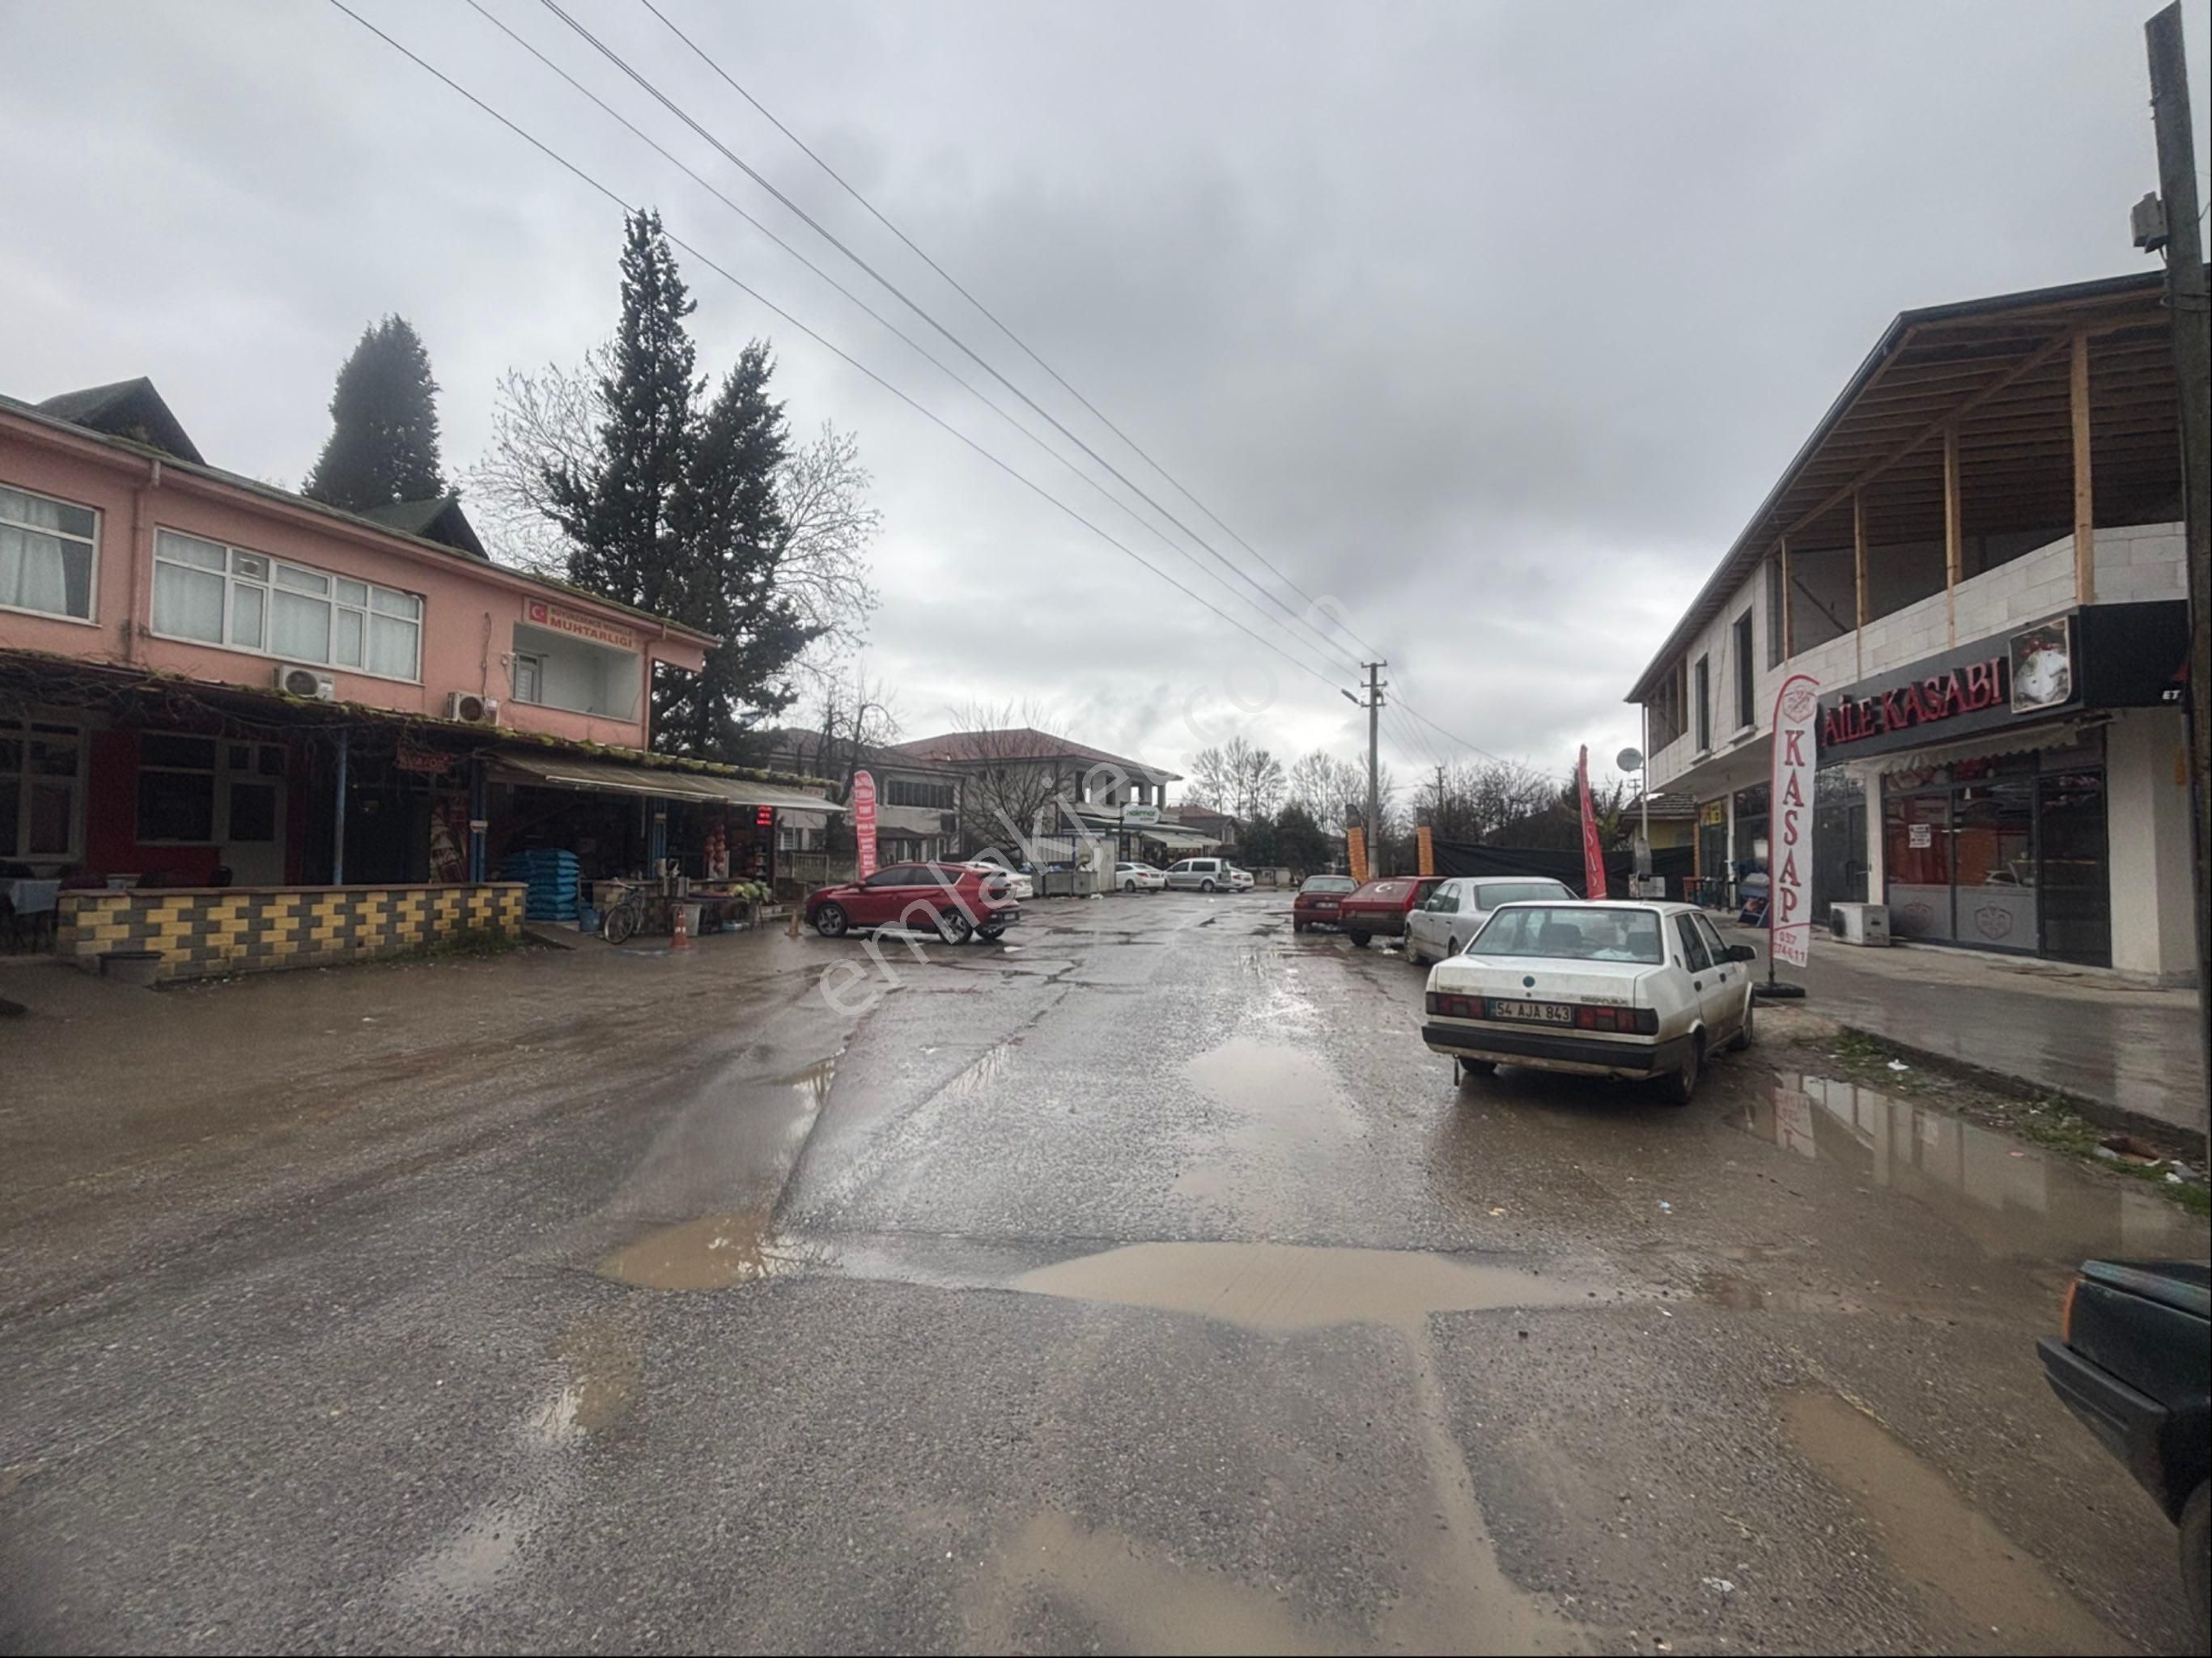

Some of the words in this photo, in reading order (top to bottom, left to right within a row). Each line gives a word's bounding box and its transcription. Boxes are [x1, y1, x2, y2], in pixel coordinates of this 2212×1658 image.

[1823, 695, 1875, 747] AİLE
[1882, 657, 2002, 734] KASABI
[1779, 729, 1806, 923] KASAP
[1497, 1002, 1512, 1016] 54
[1518, 1004, 1541, 1018] AJA
[1546, 1006, 1569, 1020] 843
